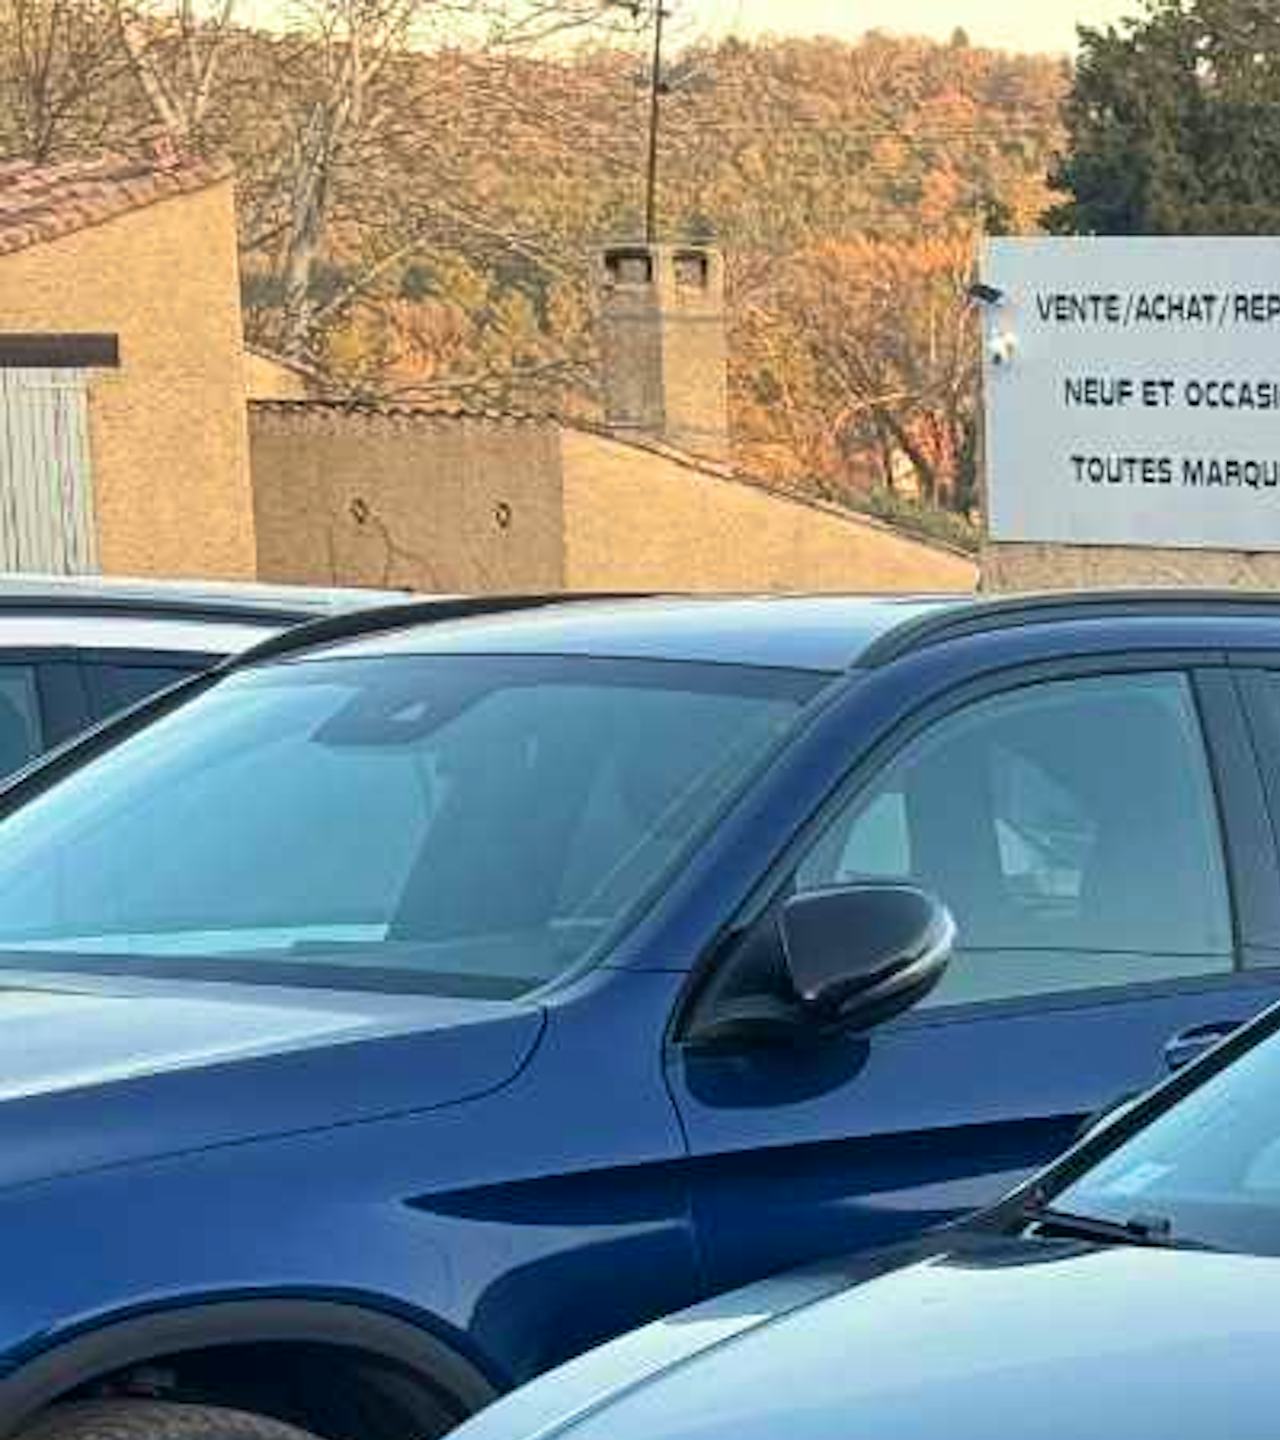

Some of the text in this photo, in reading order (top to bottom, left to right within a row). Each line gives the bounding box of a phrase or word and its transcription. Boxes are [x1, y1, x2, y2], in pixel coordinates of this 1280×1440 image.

[1063, 378, 1134, 408] NEUF
[1141, 380, 1175, 408] ET
[1070, 454, 1173, 485] TOUTES
